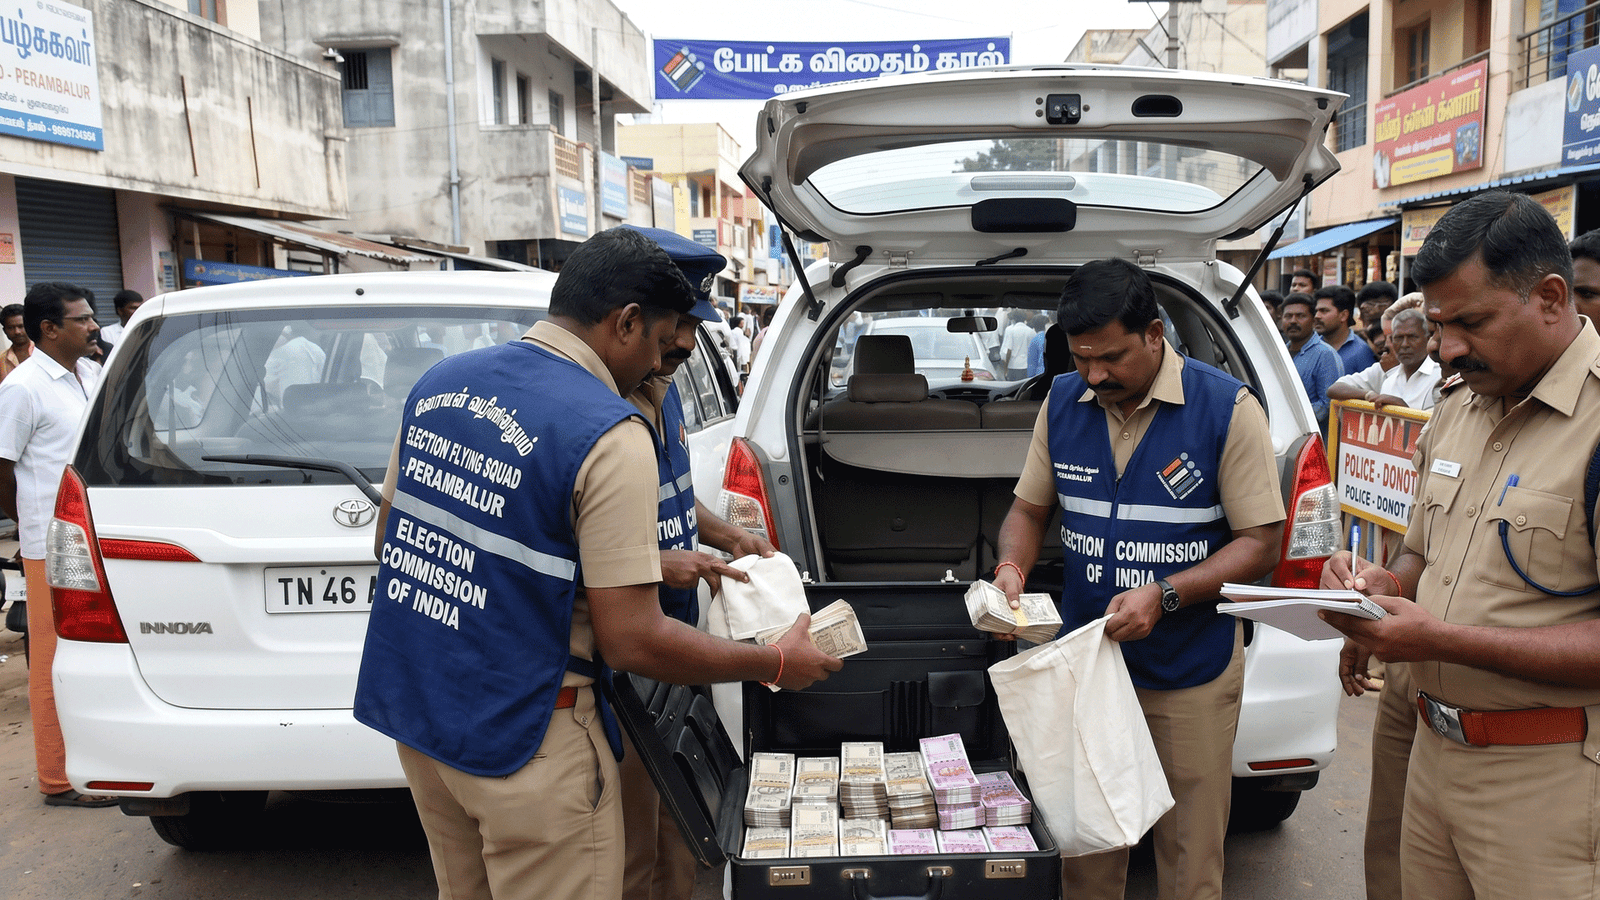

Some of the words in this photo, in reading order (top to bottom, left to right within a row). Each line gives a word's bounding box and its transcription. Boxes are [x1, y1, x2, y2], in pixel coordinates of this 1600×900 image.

[15, 67, 91, 100] PERAMBALUR
[405, 425, 451, 460] ELECTION
[450, 441, 484, 474] FLYING
[482, 457, 522, 490] SQUAD
[1344, 452, 1375, 483] POLICE
[405, 457, 506, 518] PERAMBALUR
[1345, 484, 1371, 506] POLICE
[1376, 495, 1406, 519] DONOT
[395, 517, 476, 573] ELECTION
[1060, 525, 1105, 558] ELECTION
[1115, 539, 1208, 564] COMMISSION
[277, 577, 314, 606] TN
[322, 576, 356, 604] 46
[381, 542, 488, 610] COMMISSION
[1086, 563, 1103, 583] OF
[1115, 567, 1155, 588] INDIA
[387, 577, 411, 604] OF
[412, 588, 460, 631] INDIA
[139, 621, 214, 635] INNOVA
